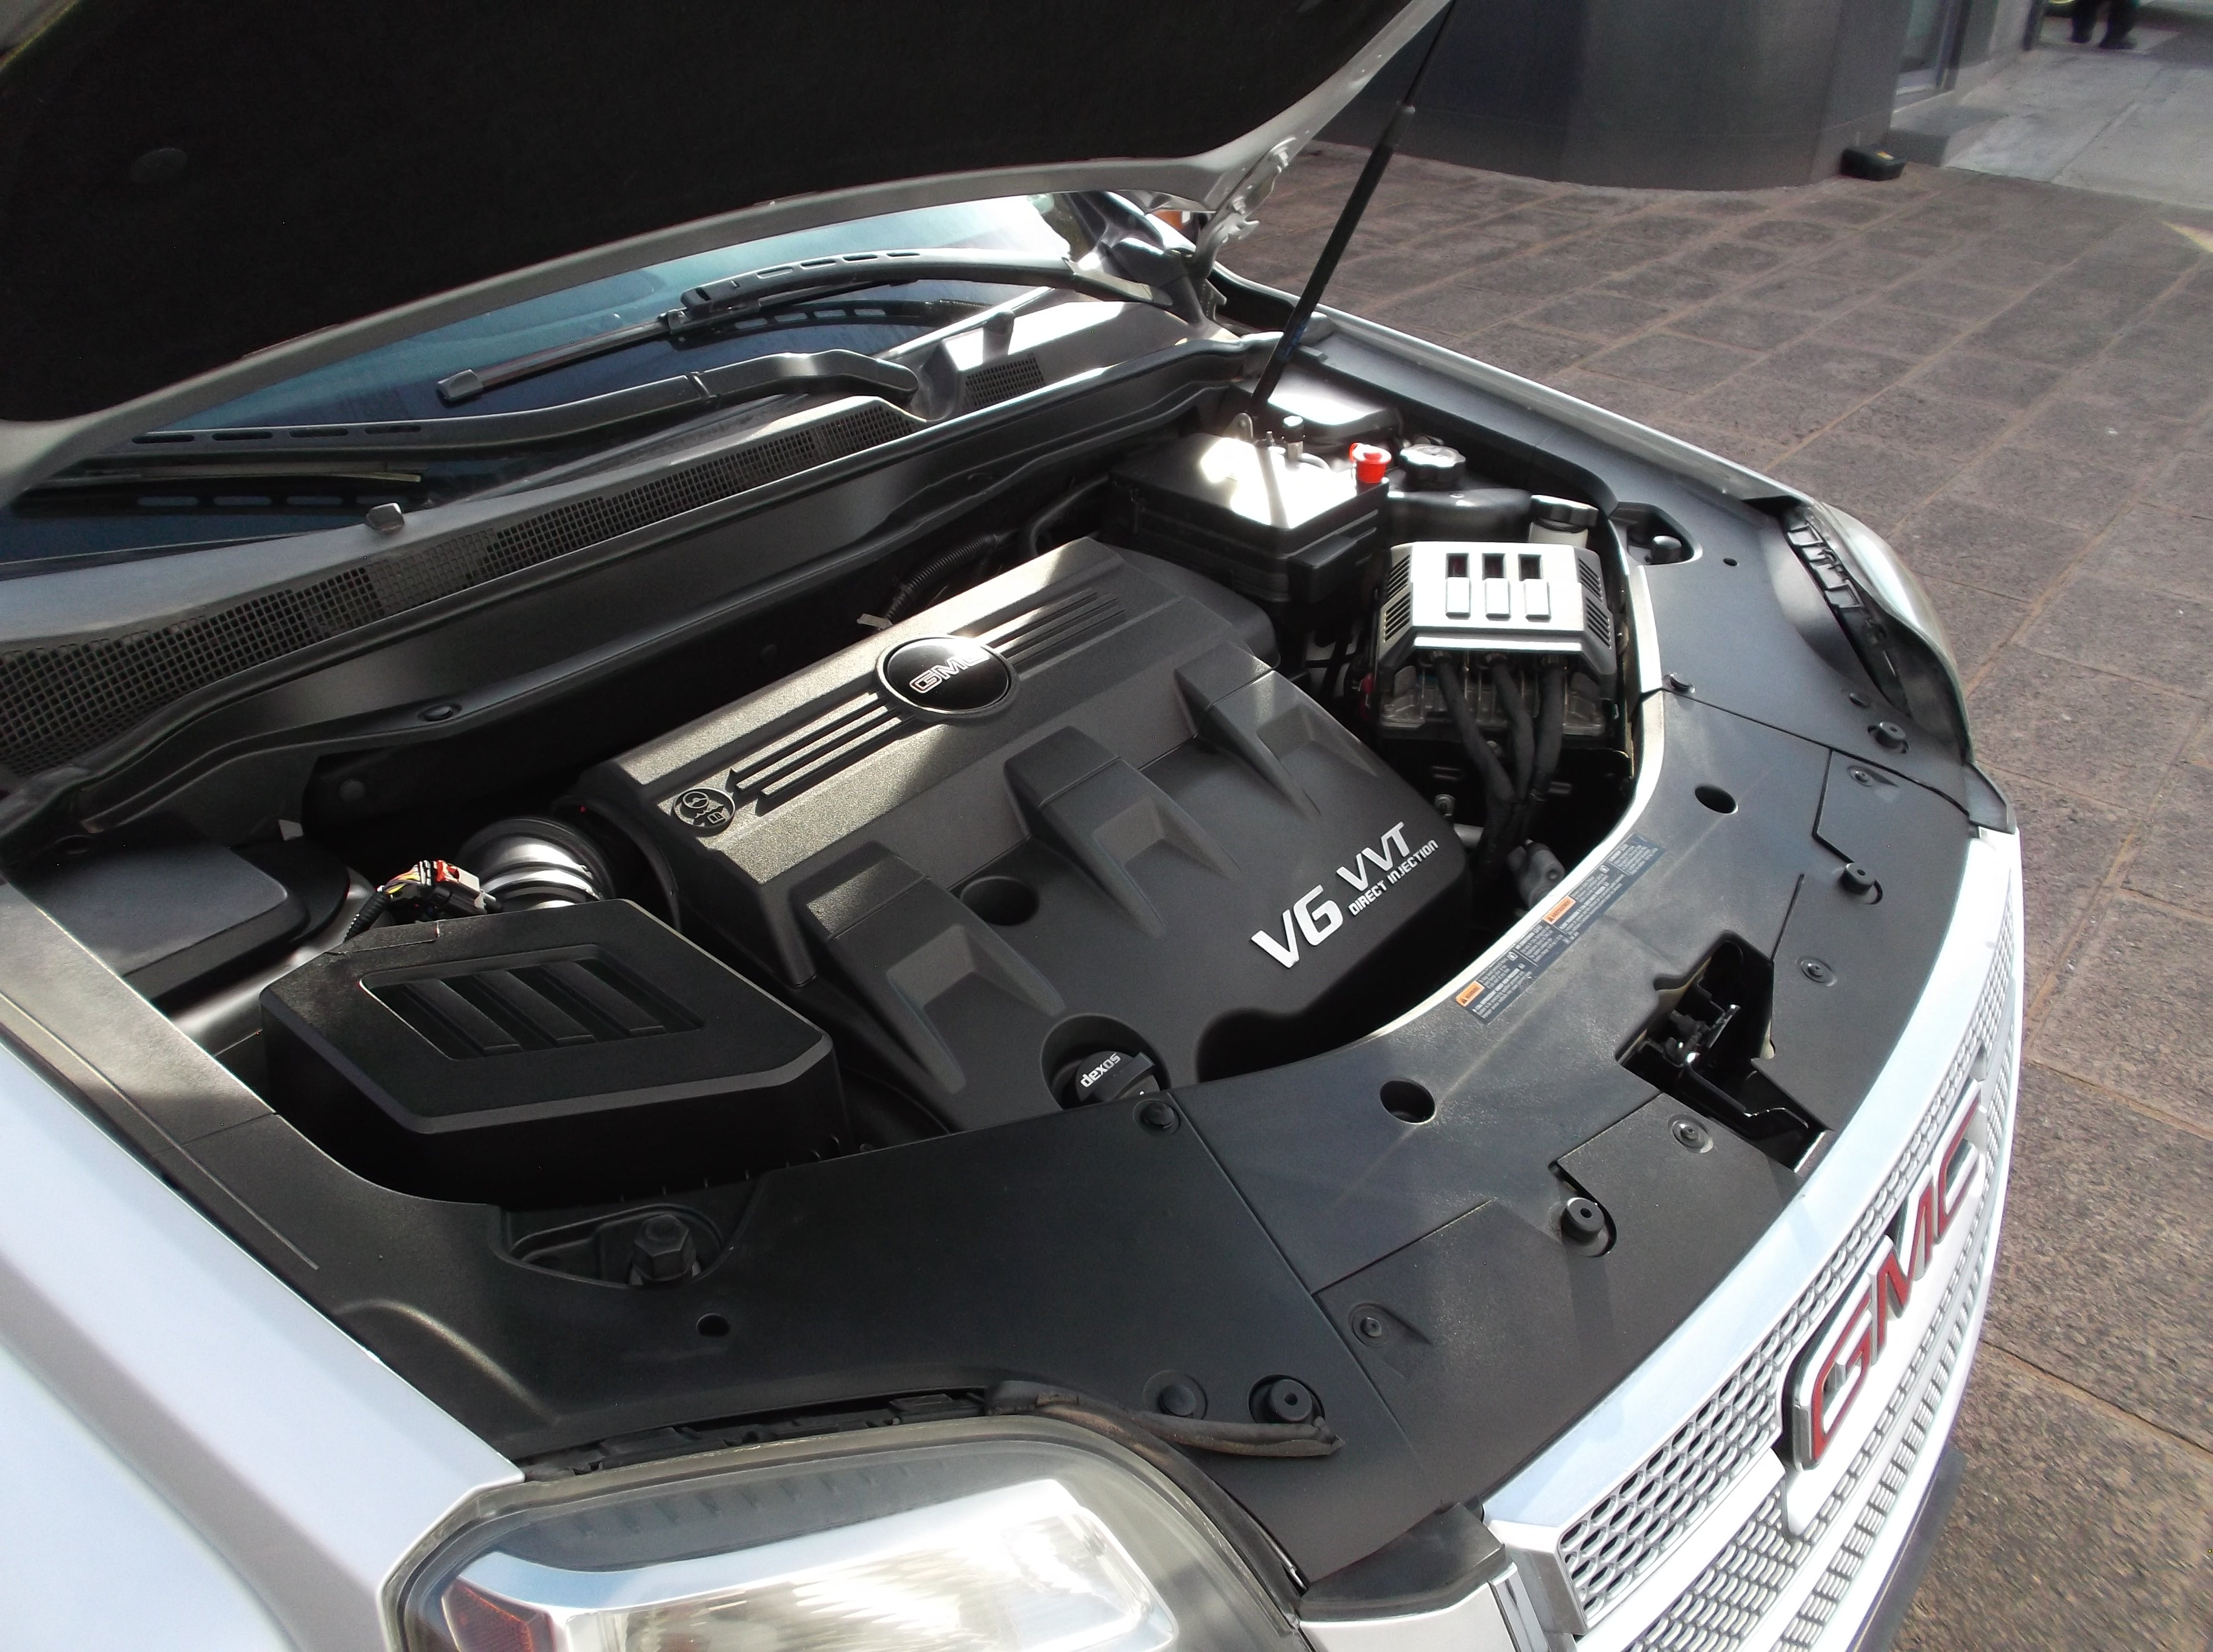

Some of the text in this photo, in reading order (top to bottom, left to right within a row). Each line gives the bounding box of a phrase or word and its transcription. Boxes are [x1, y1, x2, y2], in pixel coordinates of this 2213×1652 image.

[1251, 821, 1410, 968] V6 VVT
[1348, 839, 1439, 916] DIRECT INJECTION
[1081, 1053, 1121, 1087] dexos
[1792, 1078, 1982, 1470] GMC
